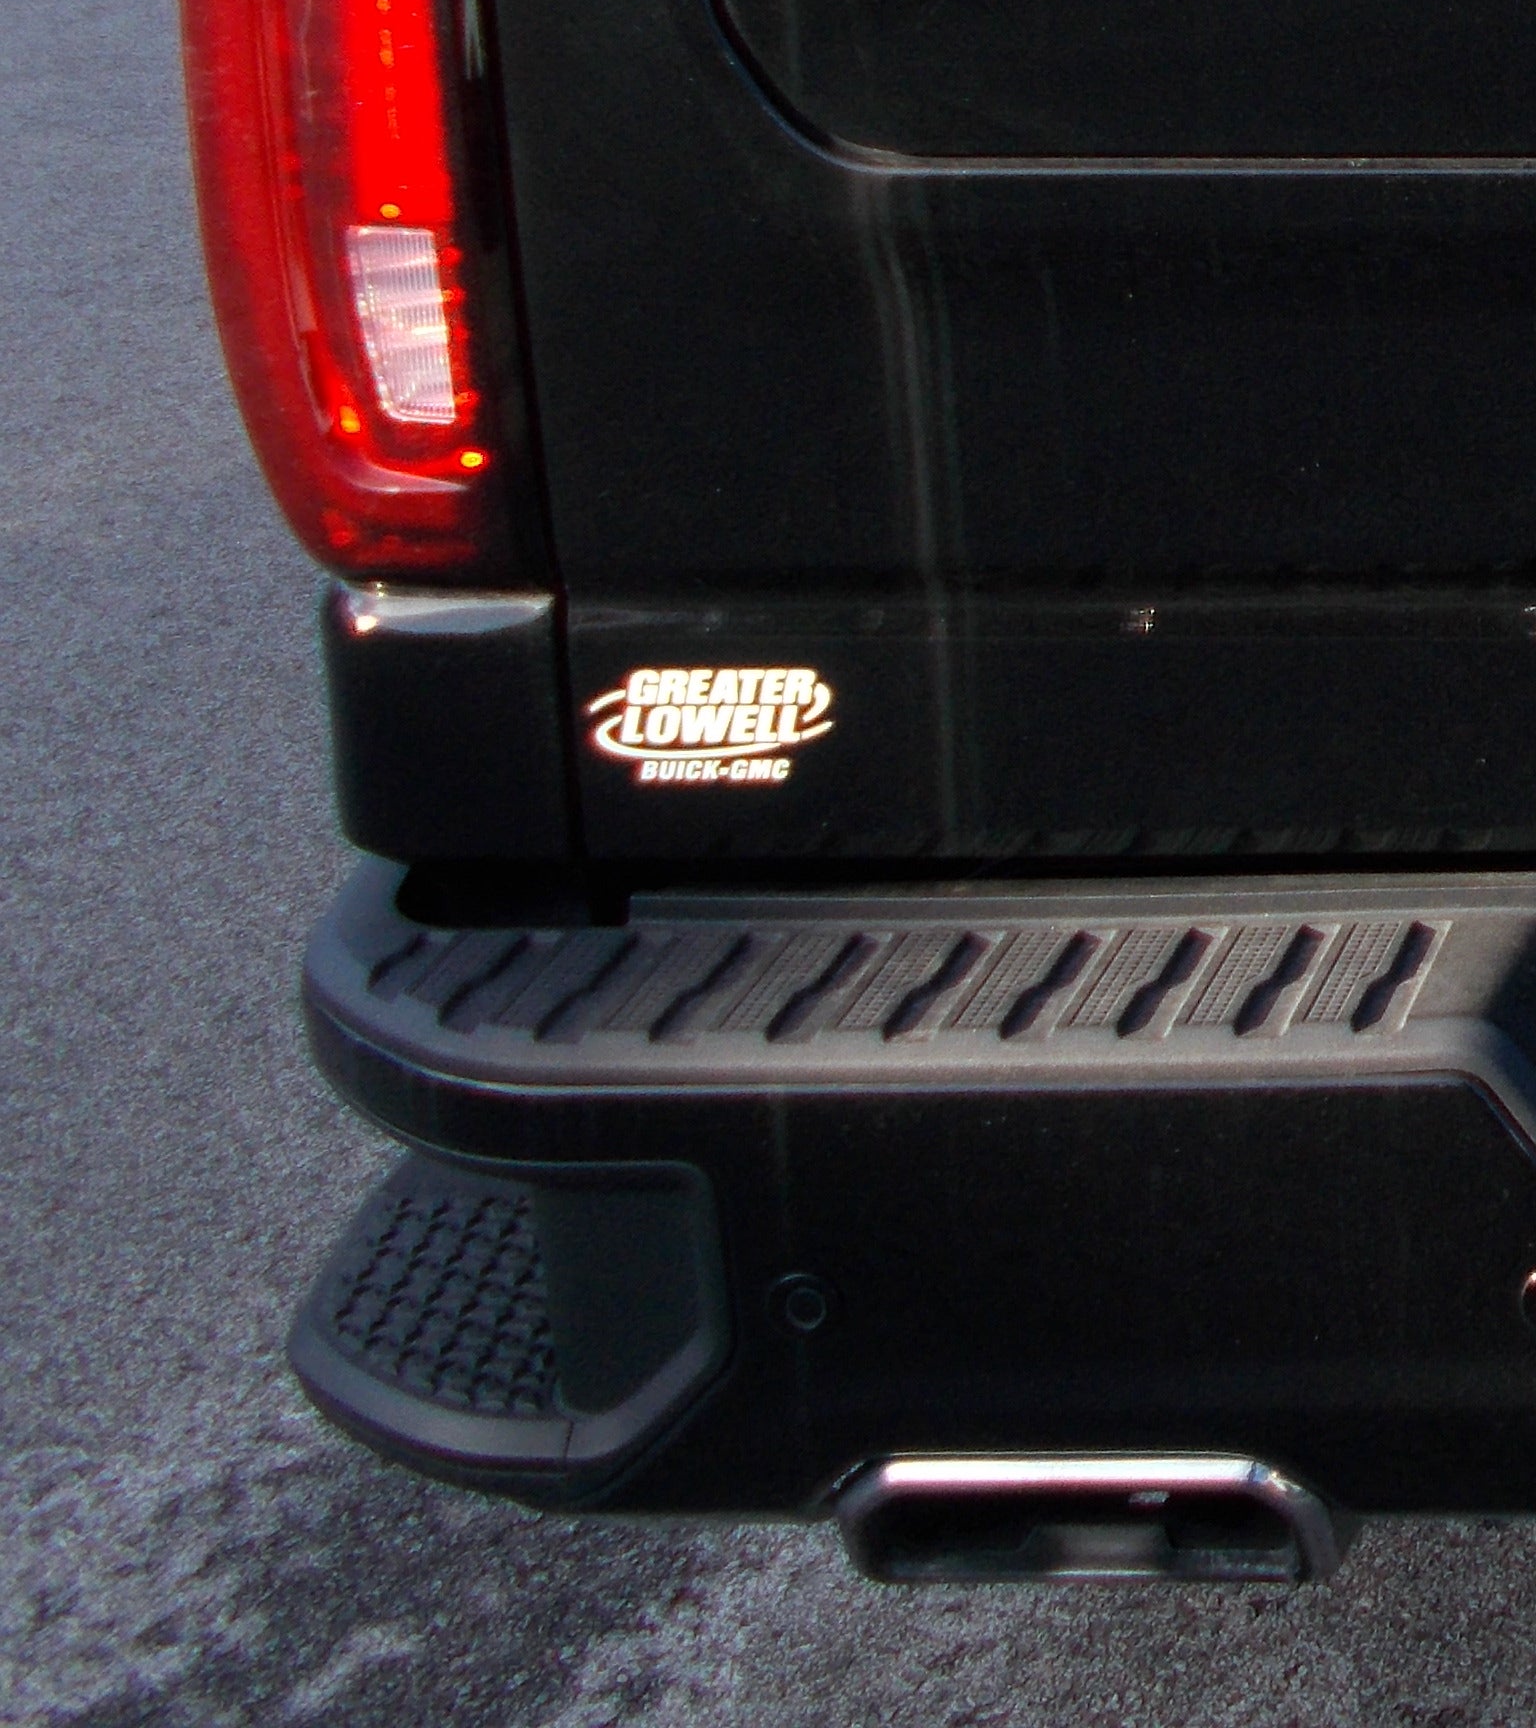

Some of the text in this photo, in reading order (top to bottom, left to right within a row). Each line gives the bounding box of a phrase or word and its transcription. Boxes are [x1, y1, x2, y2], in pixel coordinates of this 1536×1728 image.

[626, 669, 816, 706] GREATER
[620, 705, 802, 745] LOWELL
[640, 759, 792, 781] BUICK-GMC
